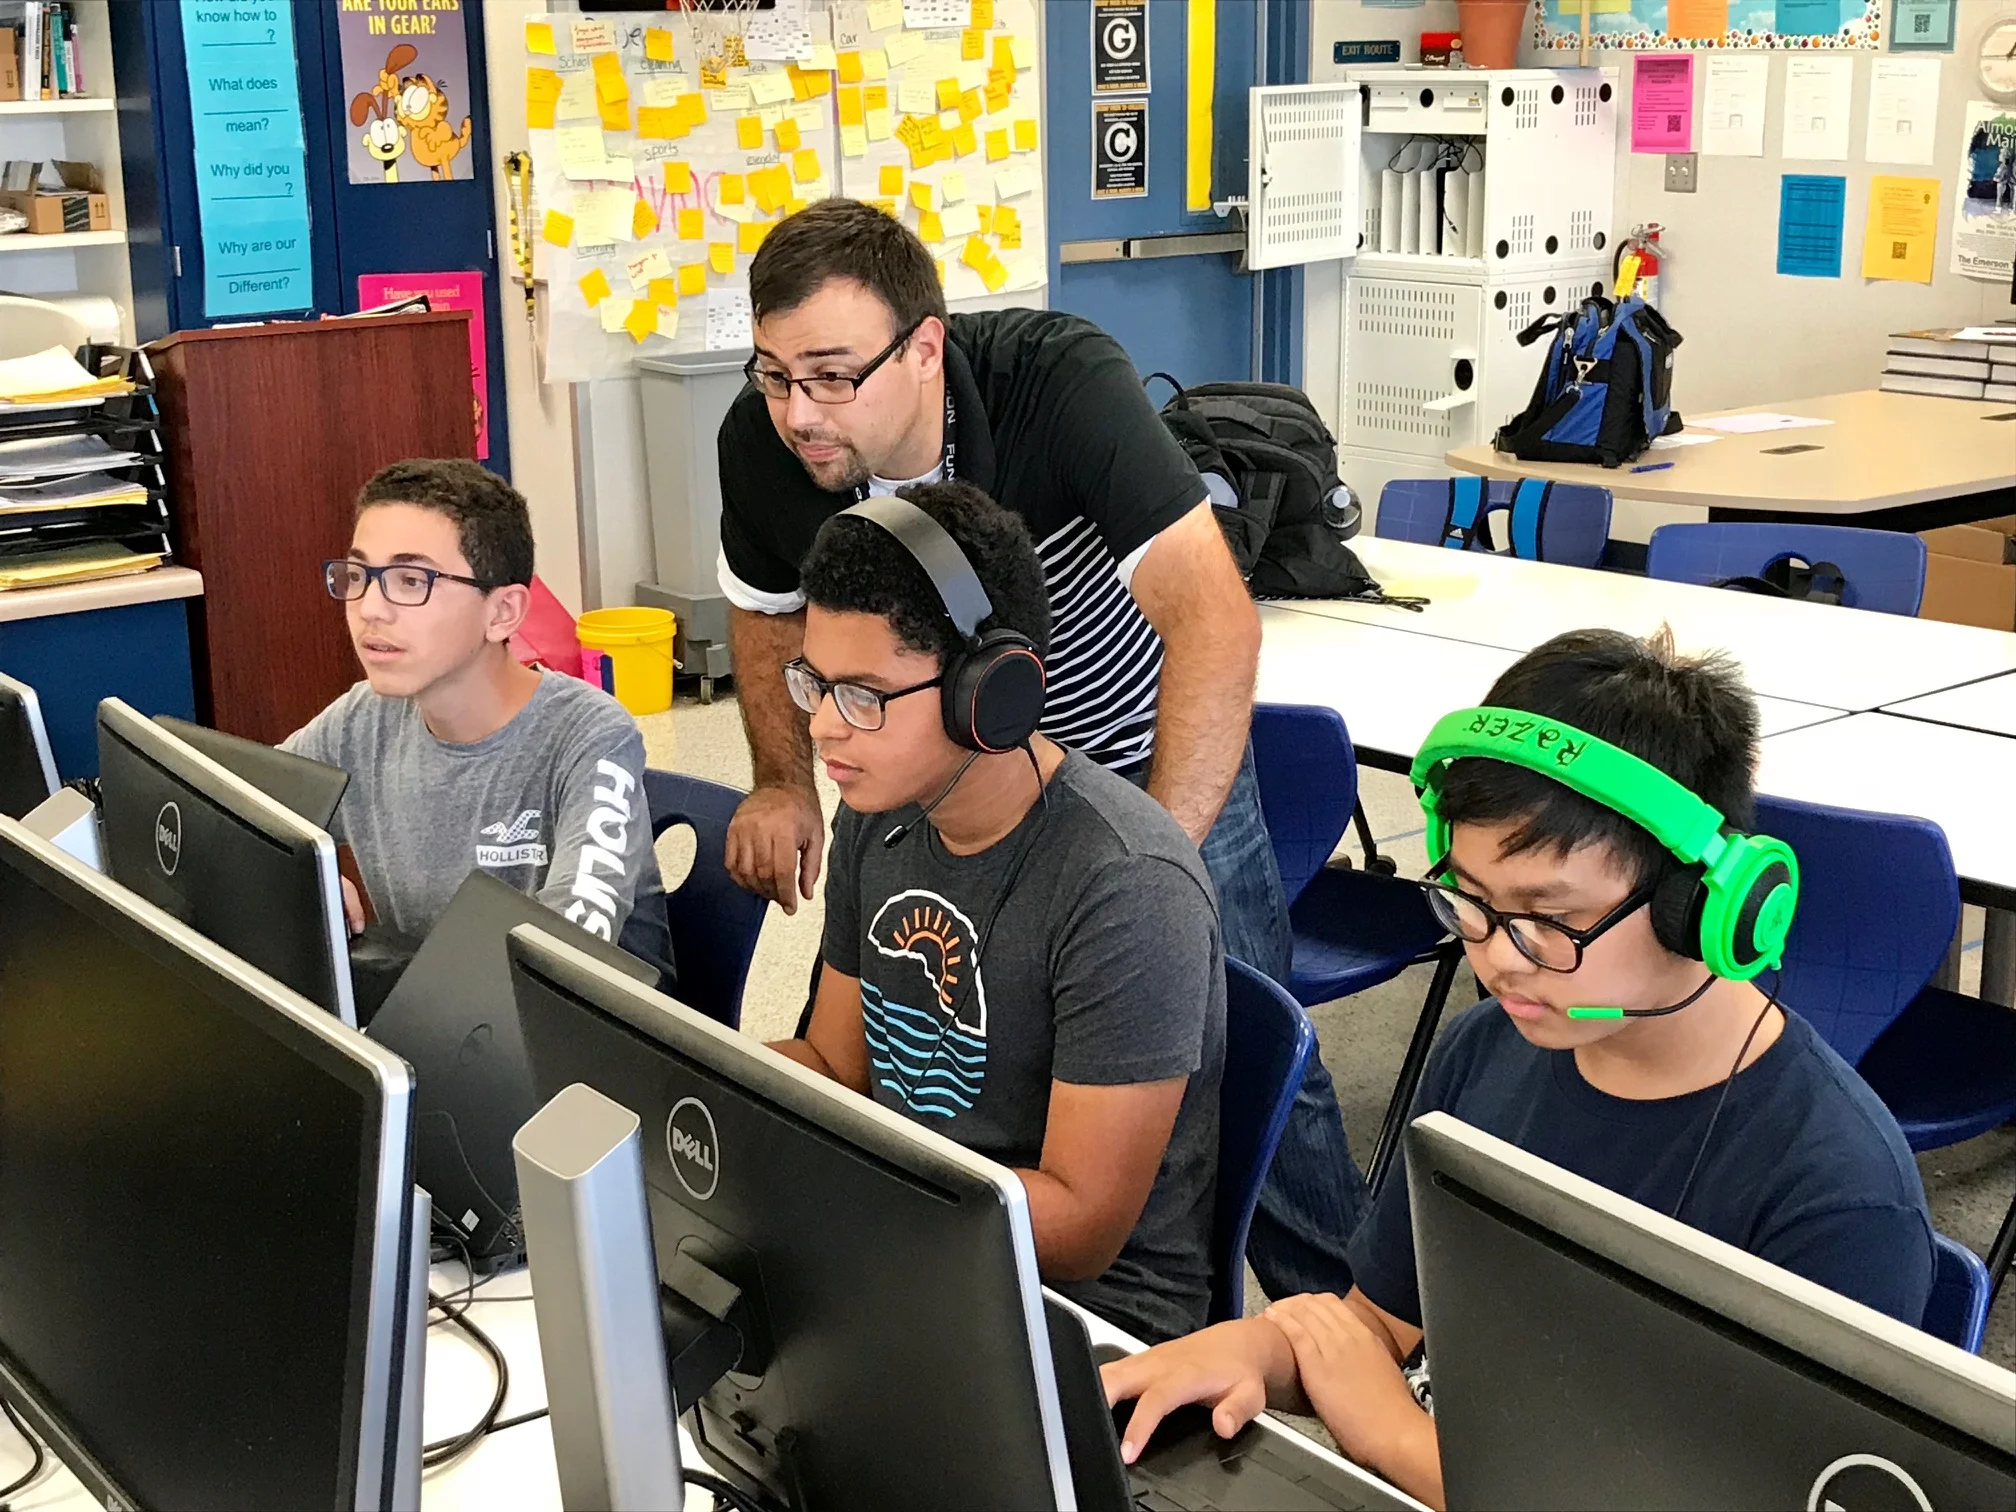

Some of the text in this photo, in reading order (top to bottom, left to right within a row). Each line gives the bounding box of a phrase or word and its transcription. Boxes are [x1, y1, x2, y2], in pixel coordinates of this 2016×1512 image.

[196, 9, 277, 23] know how to
[368, 15, 437, 35] IN GEAR?
[840, 33, 857, 45] Car
[1342, 45, 1393, 55] EXIT ROUTE
[208, 78, 278, 91] What does
[226, 118, 269, 132] mean?
[1974, 120, 2016, 137] Almo
[1986, 133, 2016, 149] Mai
[210, 162, 290, 180] Why did you
[218, 239, 297, 256] Why are our
[1958, 254, 2009, 269] The Emerson
[229, 276, 290, 295] Different?
[383, 287, 412, 300] Have
[435, 285, 461, 298] used
[159, 824, 178, 852] DELL
[480, 848, 544, 864] HOLLISTR
[673, 1126, 713, 1171] DELL
